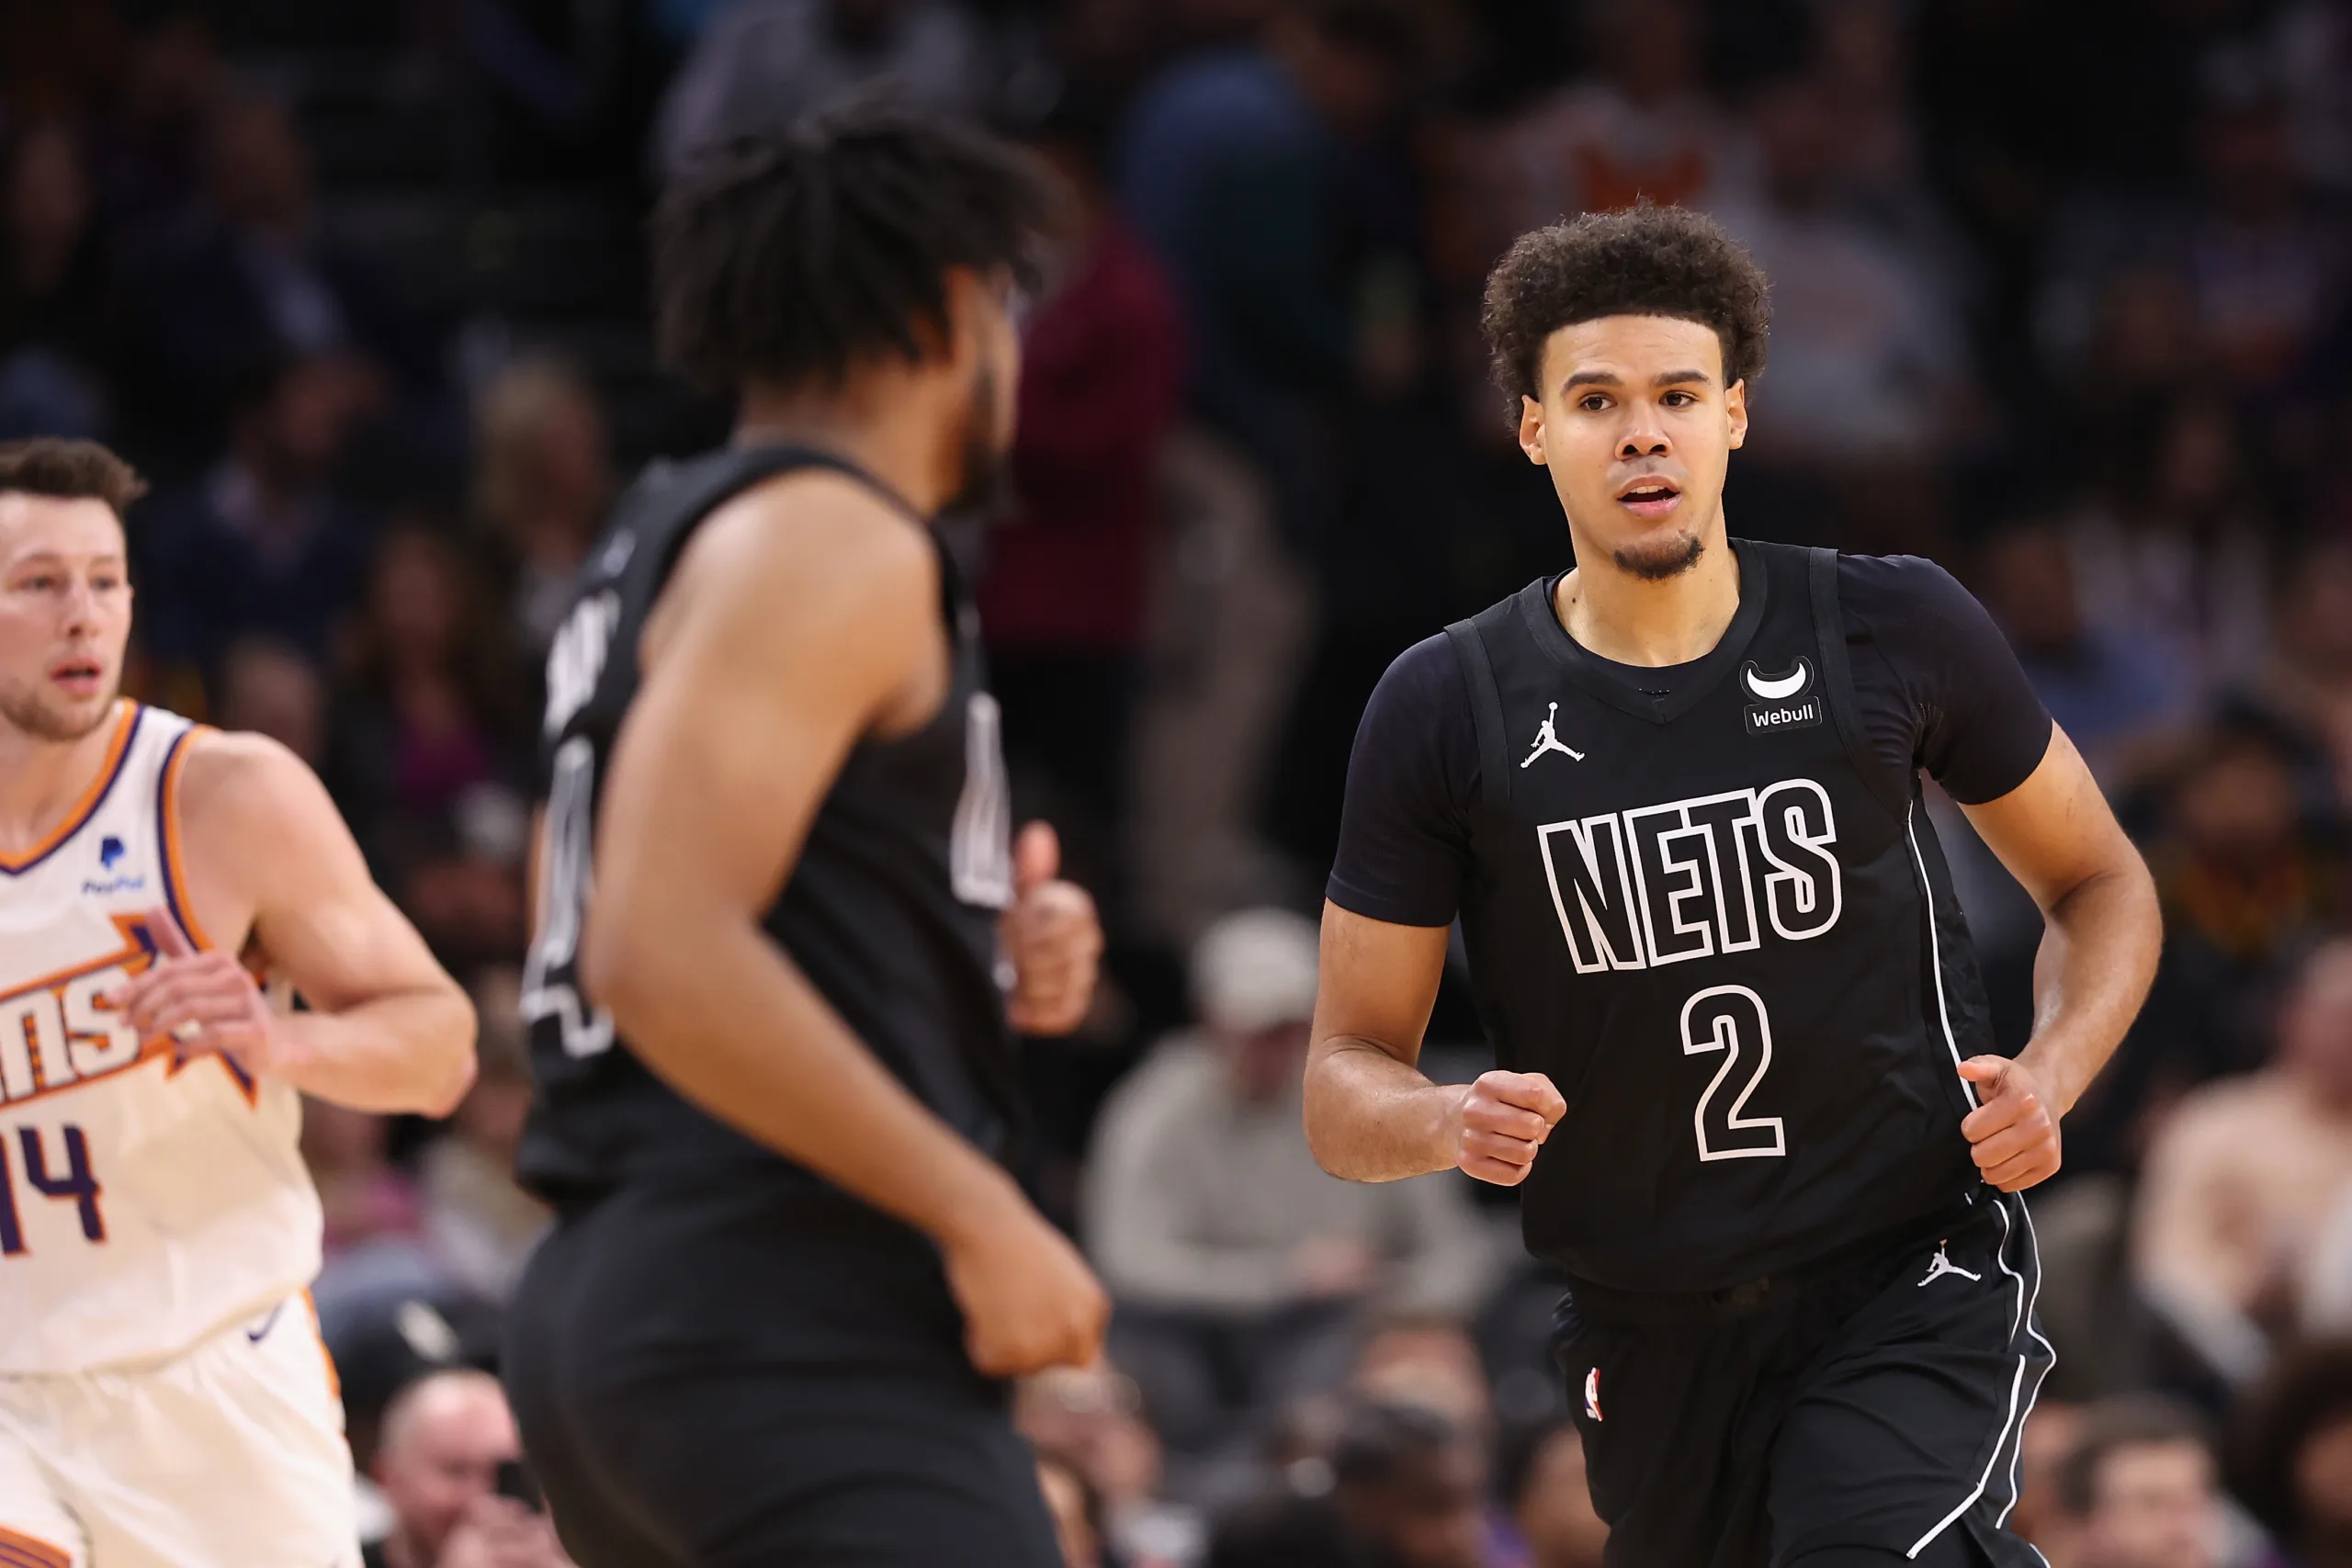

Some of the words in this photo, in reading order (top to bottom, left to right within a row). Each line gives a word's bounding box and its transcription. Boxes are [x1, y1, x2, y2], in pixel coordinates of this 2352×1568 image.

[1751, 704, 1814, 728] Webull
[1536, 778, 1842, 975] NETS
[1679, 984, 1786, 1162] 2
